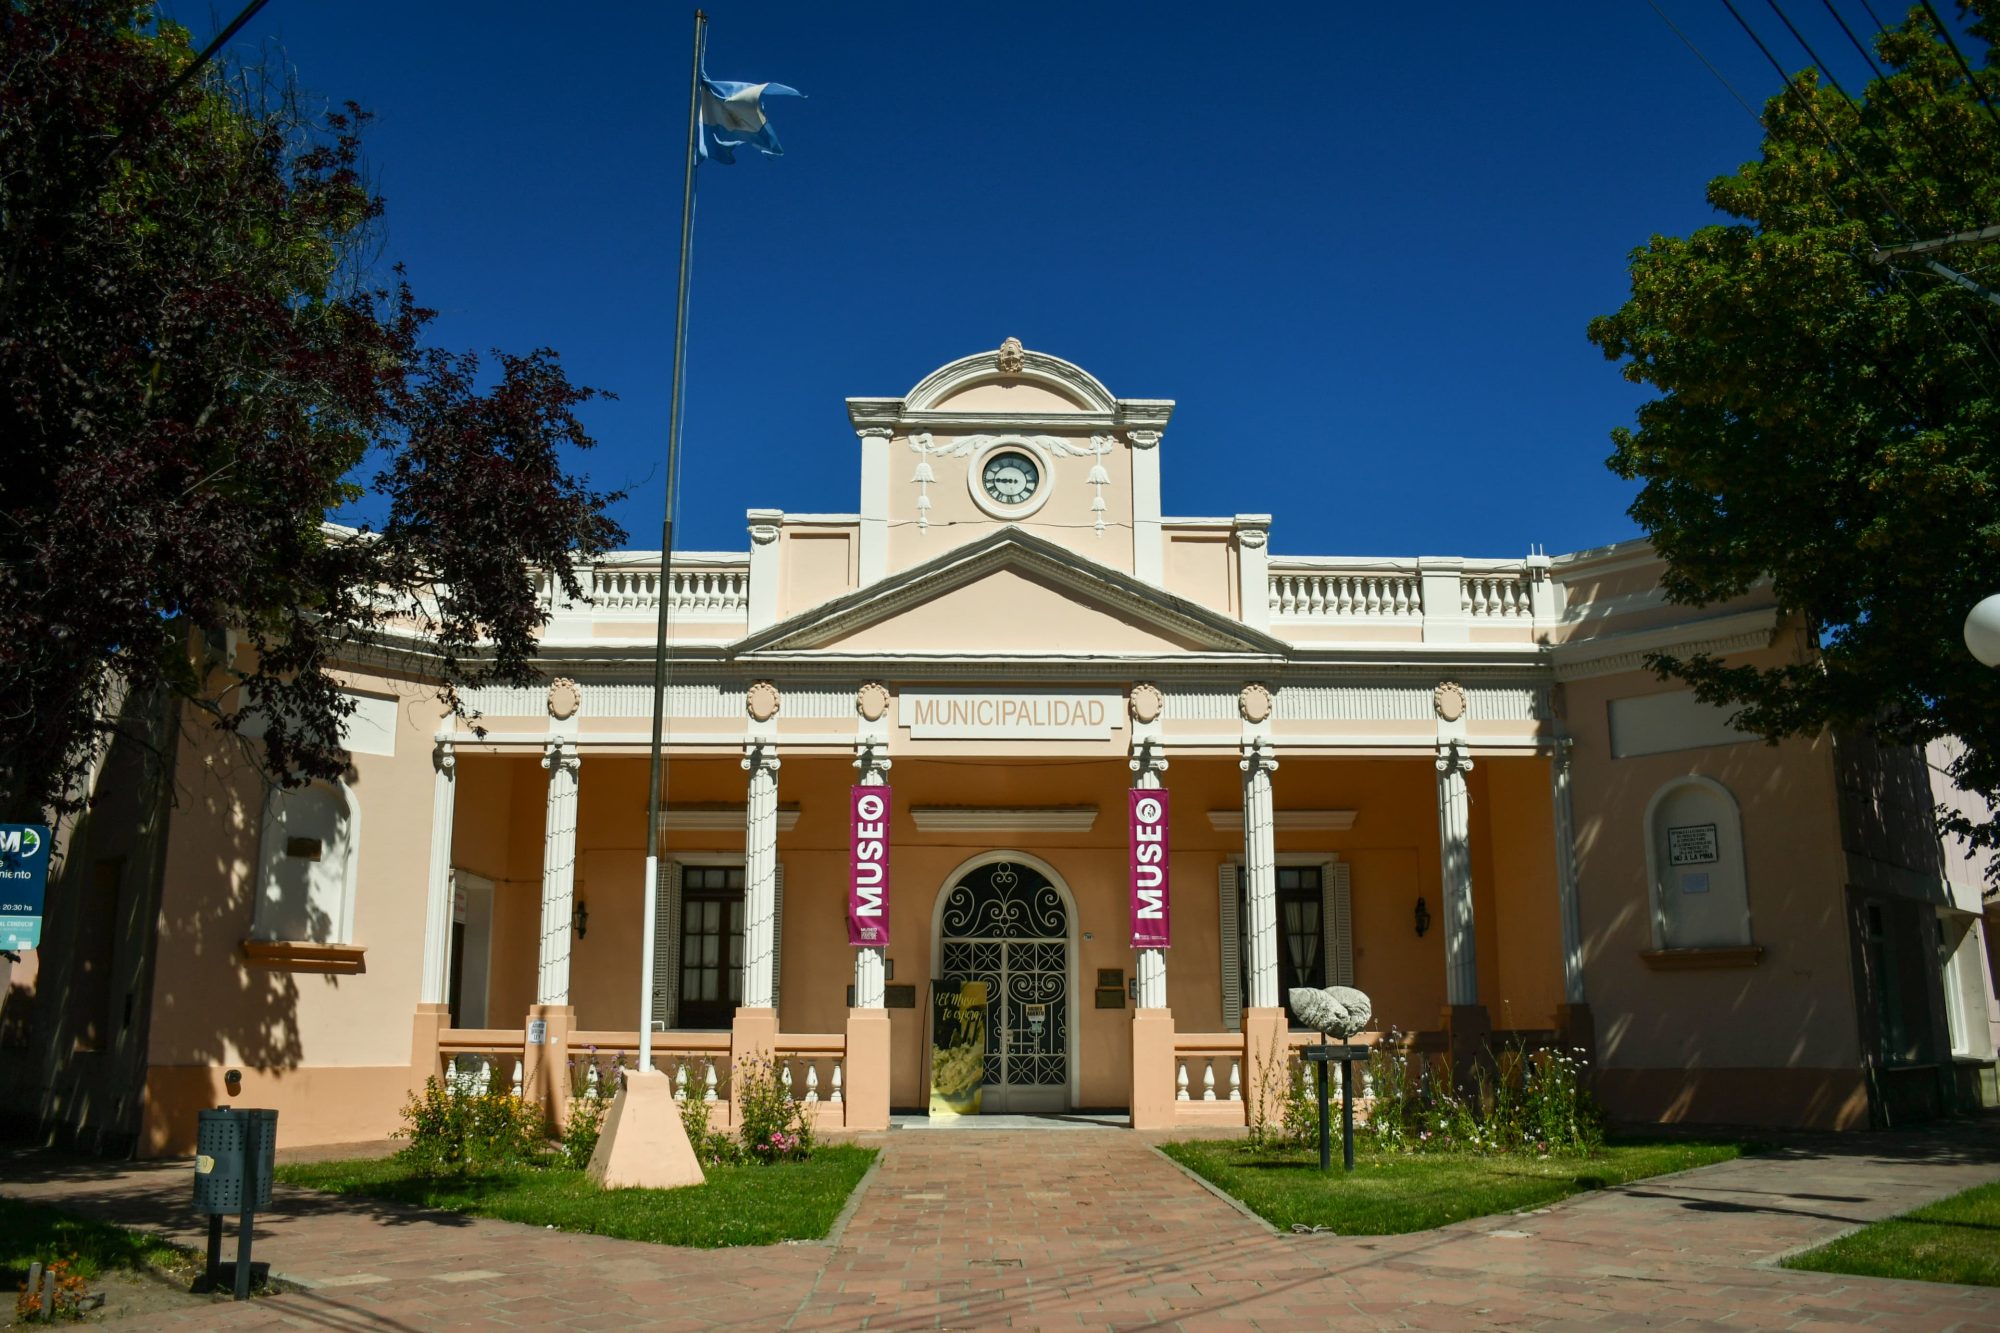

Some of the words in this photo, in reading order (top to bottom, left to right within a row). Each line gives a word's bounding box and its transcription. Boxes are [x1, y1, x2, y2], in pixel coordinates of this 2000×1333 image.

[914, 699, 1105, 726] MUNICIPALIDAD
[856, 794, 884, 917] MUSEO
[1135, 798, 1163, 919] MUSEO
